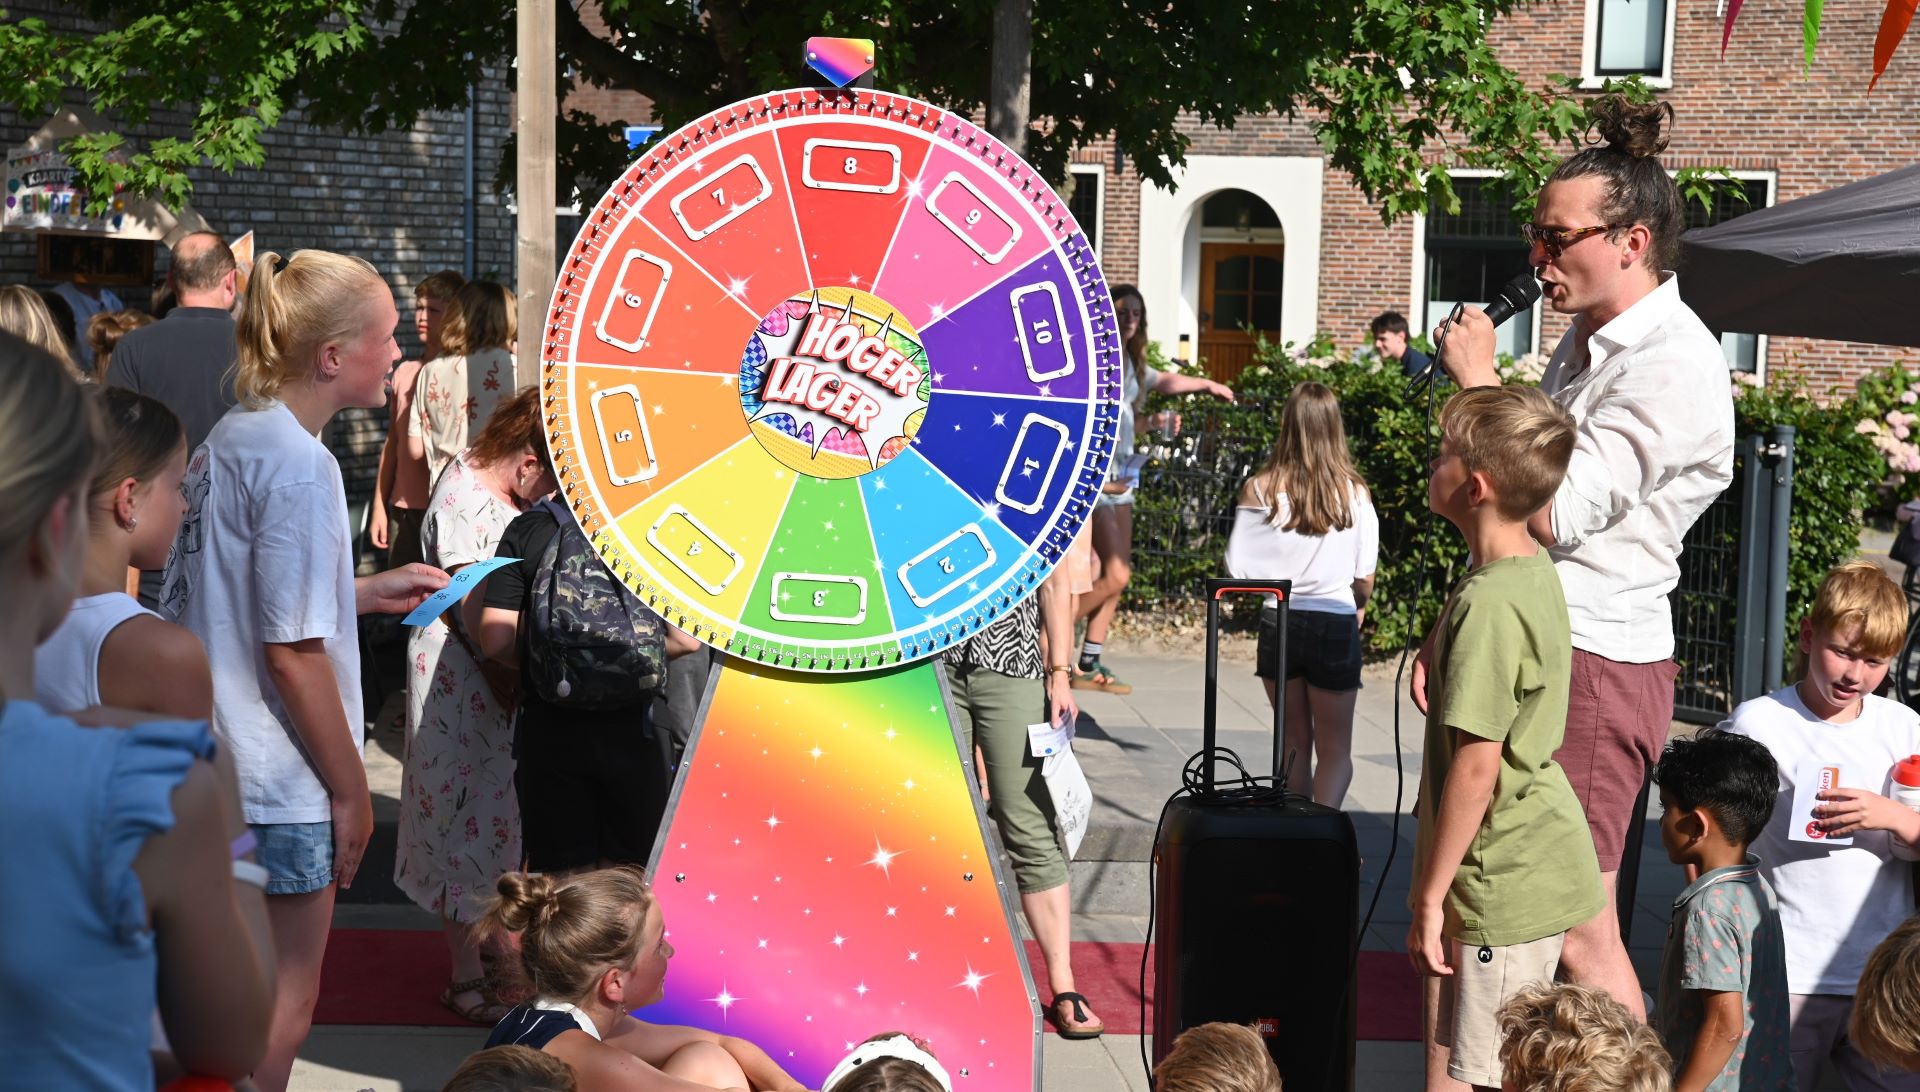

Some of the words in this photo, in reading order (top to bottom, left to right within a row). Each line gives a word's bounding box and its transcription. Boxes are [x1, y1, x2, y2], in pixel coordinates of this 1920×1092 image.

[844, 157, 857, 175] 8
[27, 168, 77, 186] KAARTVE
[711, 187, 726, 207] 7
[22, 193, 107, 218] EINDFEE
[965, 208, 982, 225] 9
[584, 249, 593, 259] 11
[623, 293, 642, 308] 6
[561, 315, 568, 325] 94
[558, 332, 565, 342] 90
[1032, 317, 1052, 345] 10
[795, 312, 922, 397] HOGER
[762, 357, 881, 432] LAGER
[614, 429, 633, 443] 5
[1023, 456, 1040, 471] 1
[1070, 504, 1078, 512] 9
[1061, 518, 1071, 528] 13
[1052, 532, 1062, 543] 17
[686, 540, 703, 556] 4
[1042, 546, 1052, 556] 21
[938, 556, 955, 574] 2
[812, 590, 825, 607] 3
[1819, 771, 1830, 790] ken
[1260, 1023, 1275, 1033] JBL
